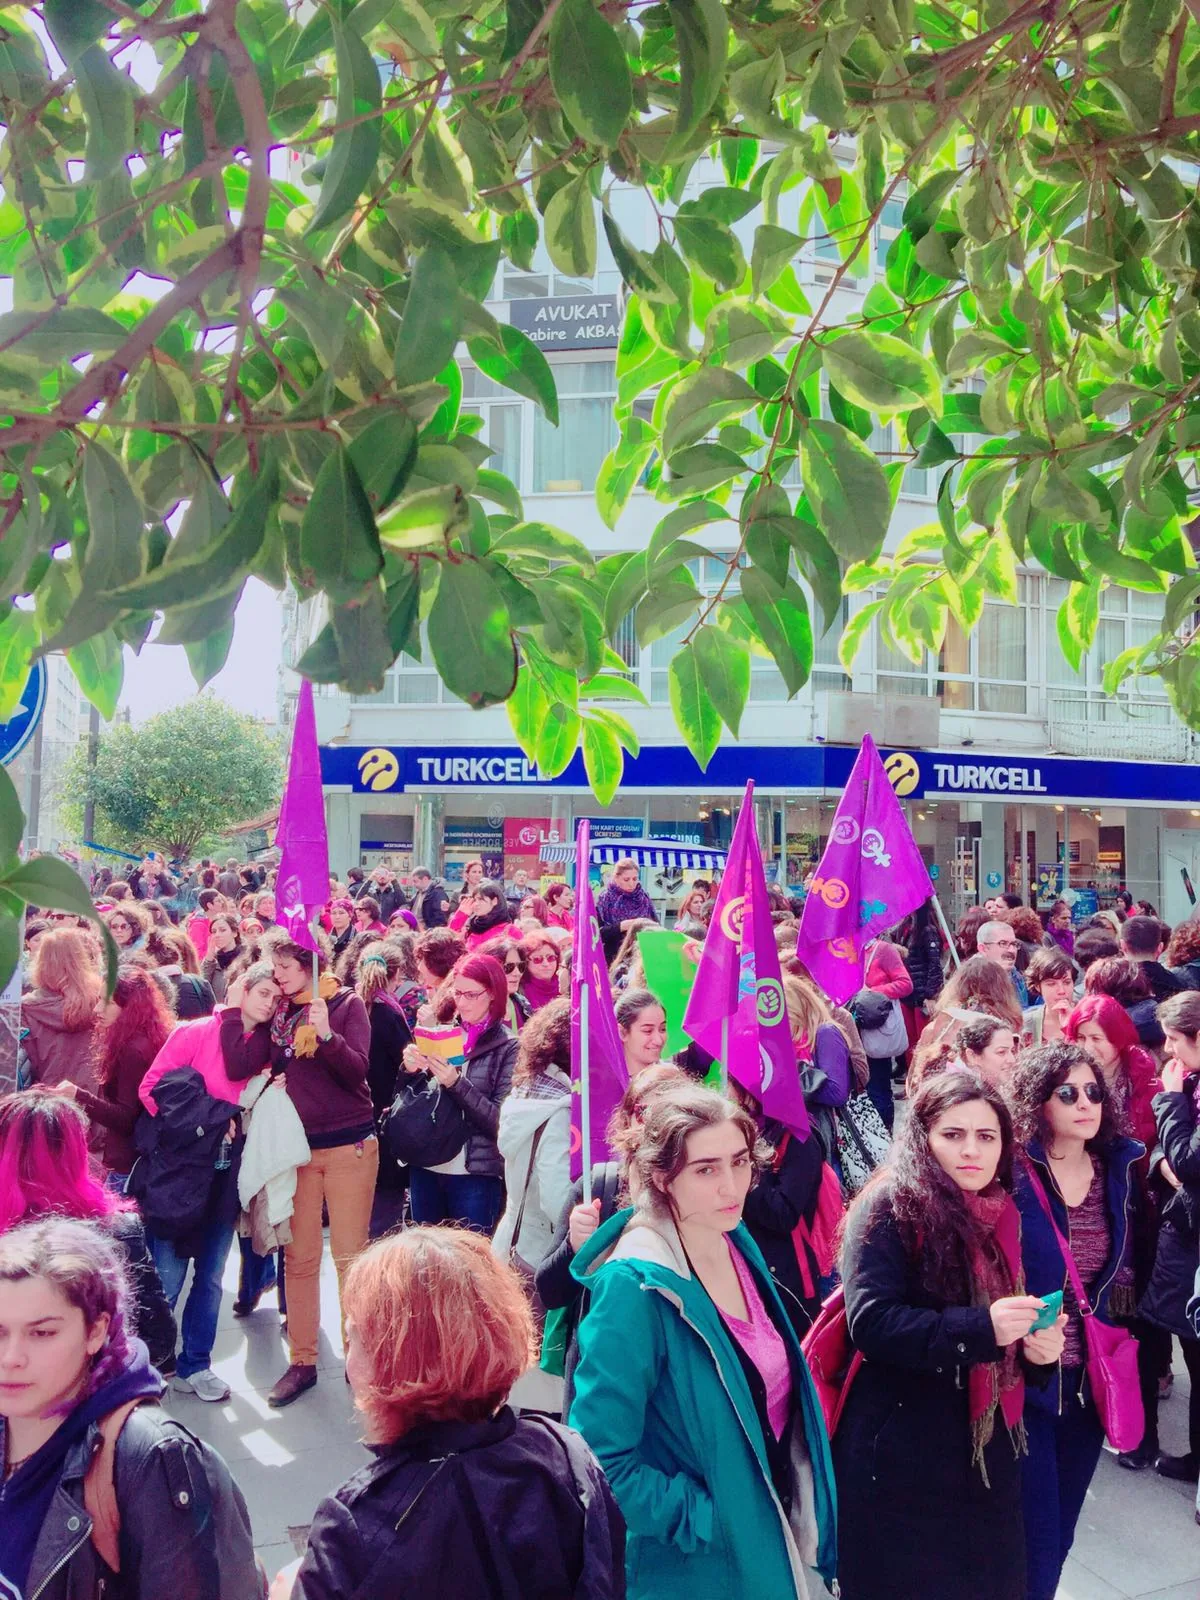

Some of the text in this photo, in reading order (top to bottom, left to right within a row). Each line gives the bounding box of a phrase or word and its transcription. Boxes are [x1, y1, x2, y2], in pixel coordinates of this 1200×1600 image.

[534, 303, 612, 322] AVUKAT
[575, 325, 621, 339] AKBA
[933, 763, 1047, 791] TURKCELL
[539, 829, 560, 843] LG
